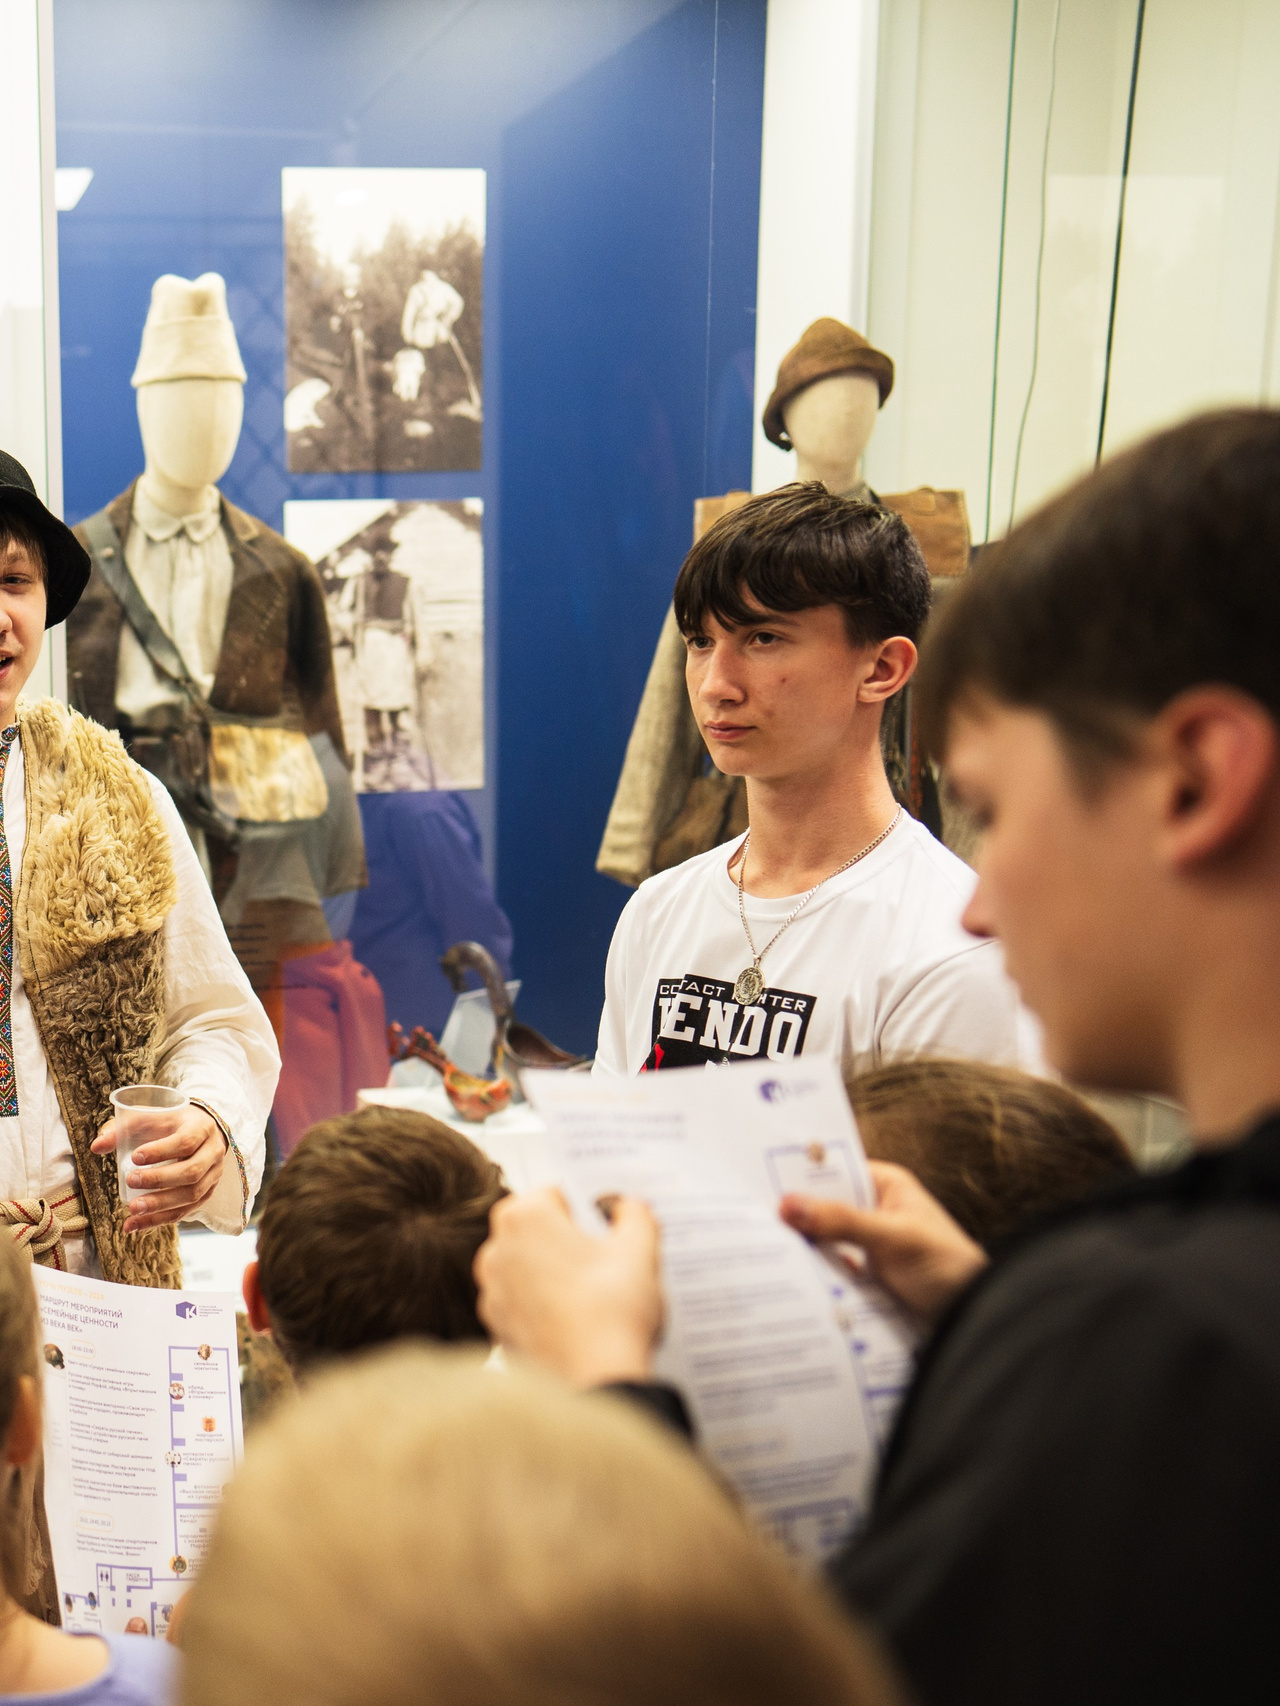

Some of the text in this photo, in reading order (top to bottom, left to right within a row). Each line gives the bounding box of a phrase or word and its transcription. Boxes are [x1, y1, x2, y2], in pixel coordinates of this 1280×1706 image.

[40, 1294, 123, 1319] МАРШРУТ МЕРОПРИЯТИЙ
[41, 1306, 119, 1328] «СЕМЕЙНЫЕ ЦЕННОСТИ
[50, 1319, 66, 1329] ВЕКА
[66, 1324, 83, 1333] ВЕК»
